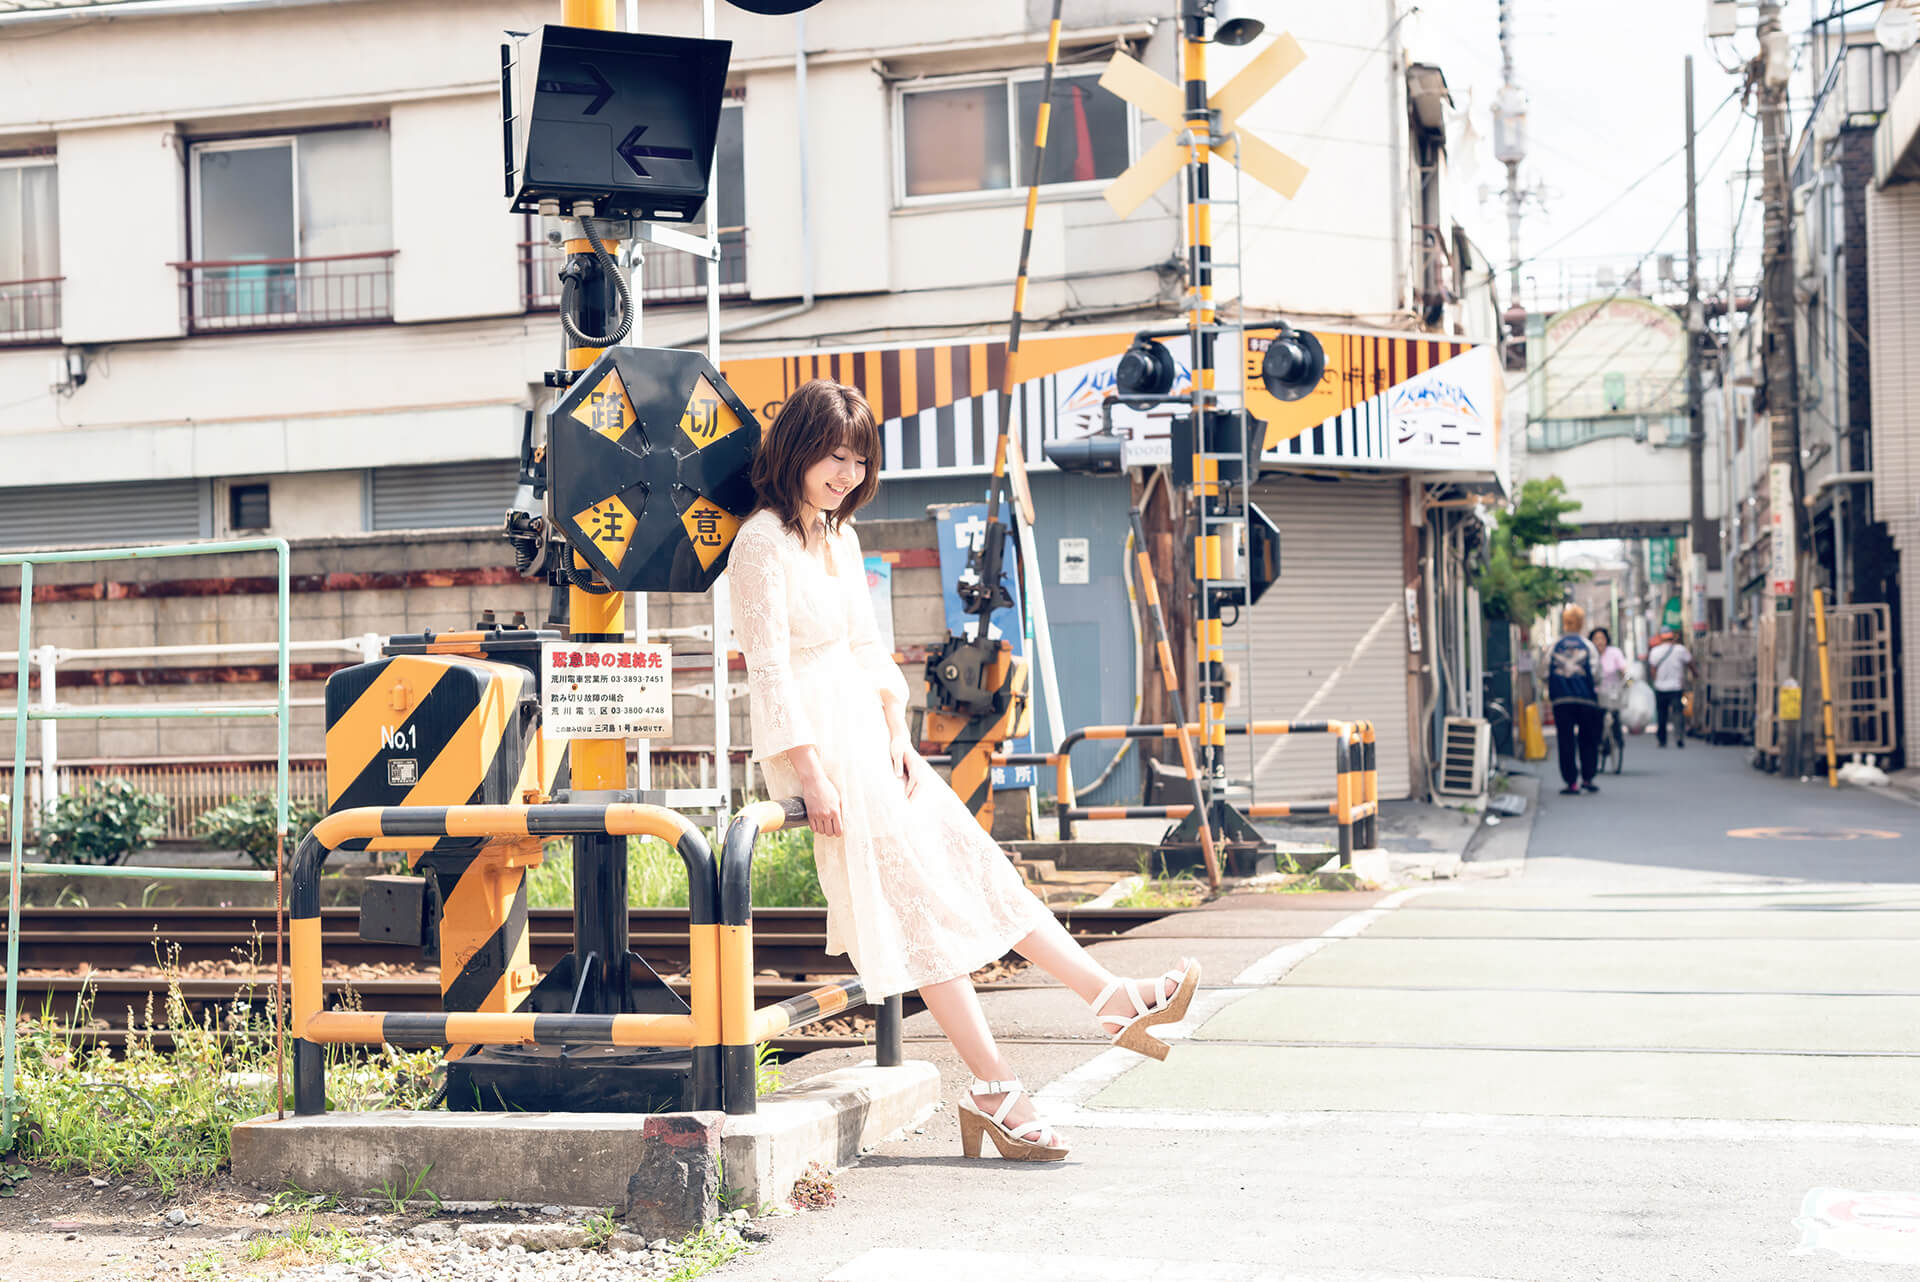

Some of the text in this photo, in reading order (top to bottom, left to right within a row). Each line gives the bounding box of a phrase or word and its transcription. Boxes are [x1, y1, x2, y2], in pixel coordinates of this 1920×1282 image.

[1398, 418, 1481, 446] ジョニー
[552, 652, 662, 668] 緊急時の連絡先
[551, 675, 664, 683] 荒川電車営業所 03-3893-7451
